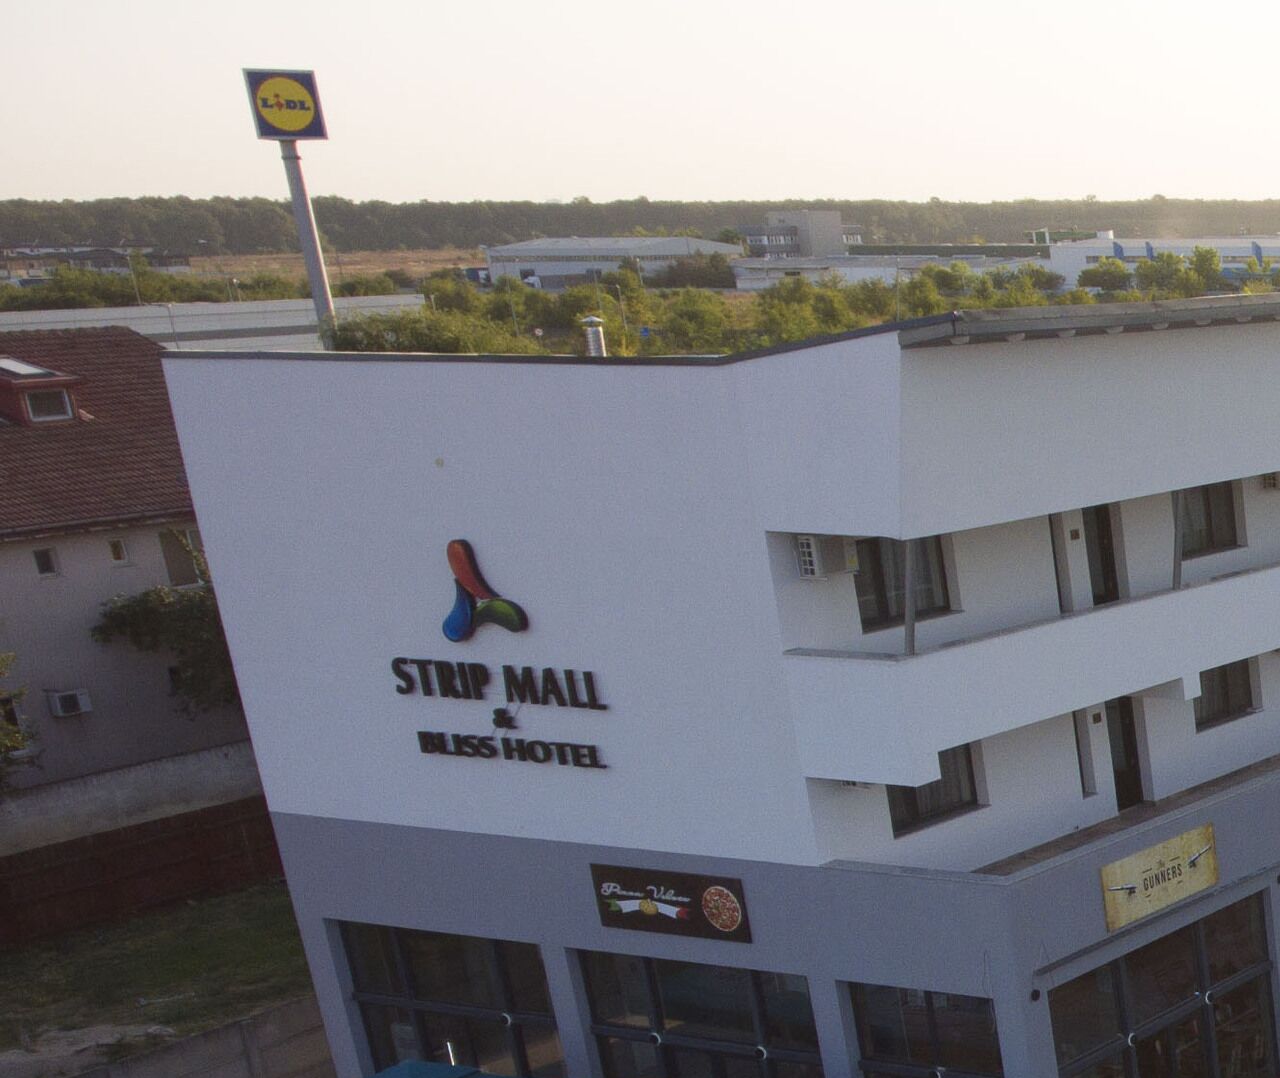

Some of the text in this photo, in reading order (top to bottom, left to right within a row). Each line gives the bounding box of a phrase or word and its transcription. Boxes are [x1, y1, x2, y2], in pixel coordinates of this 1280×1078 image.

[391, 657, 608, 711] STRIP MALL
[492, 707, 518, 730] &
[417, 730, 608, 769] BLISS HOTEL
[1143, 863, 1183, 891] GUNNERS
